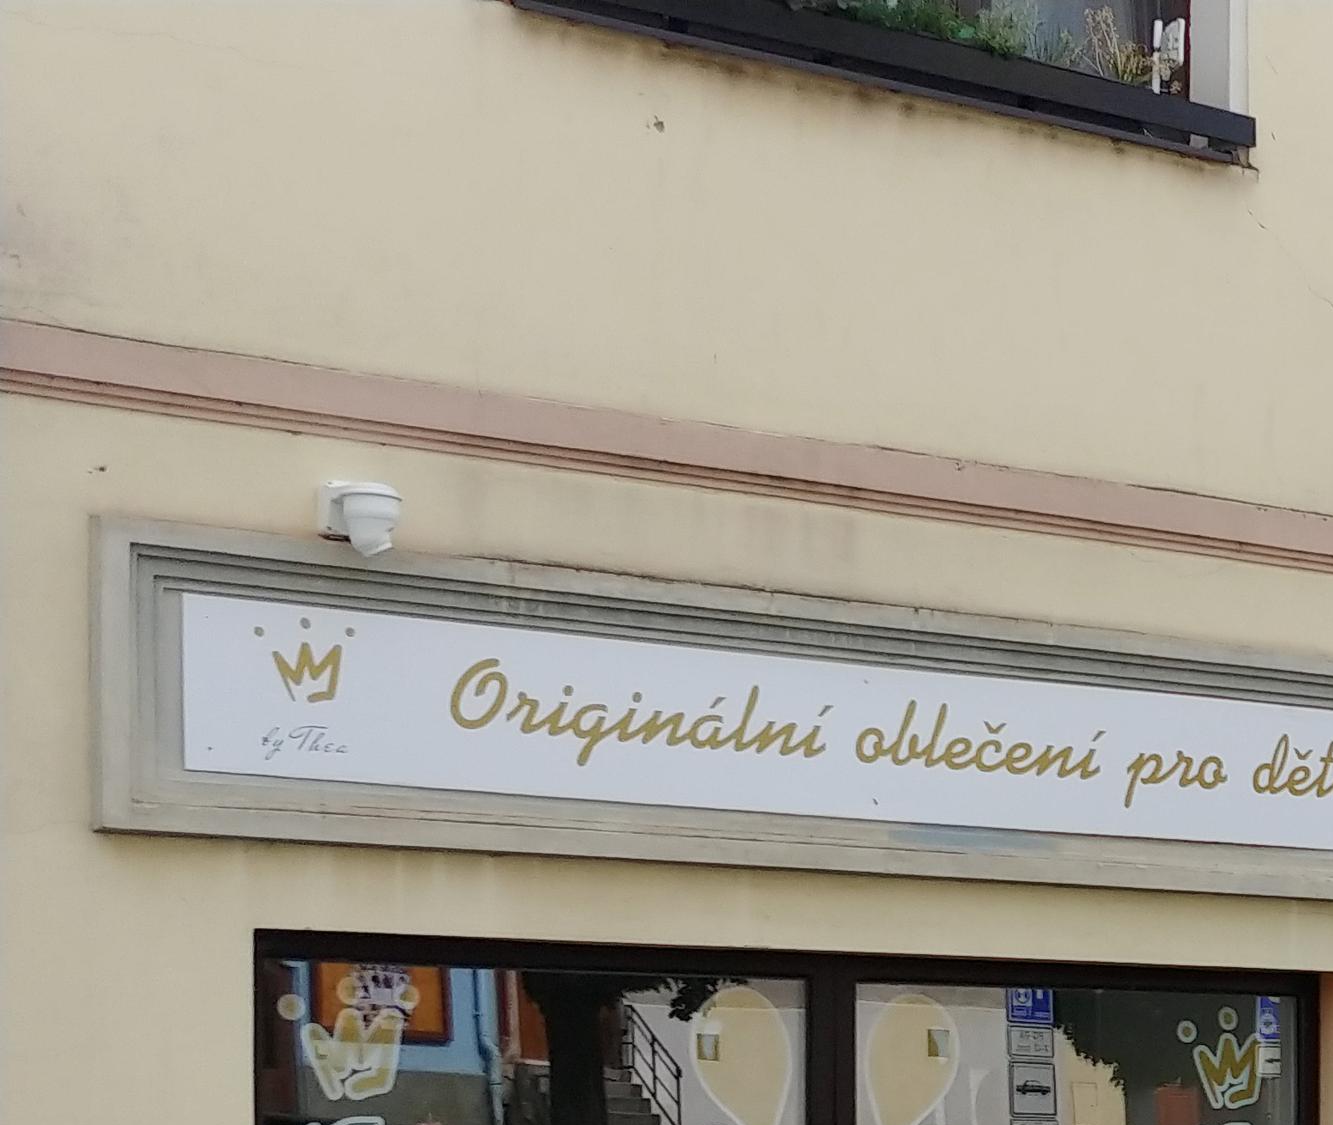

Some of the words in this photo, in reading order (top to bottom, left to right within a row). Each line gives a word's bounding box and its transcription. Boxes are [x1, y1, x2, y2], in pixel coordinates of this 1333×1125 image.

[262, 727, 284, 760] by
[288, 725, 348, 754] Thea
[450, 658, 834, 767] Originální
[856, 700, 1107, 780] oblečení
[1126, 750, 1228, 808] pro
